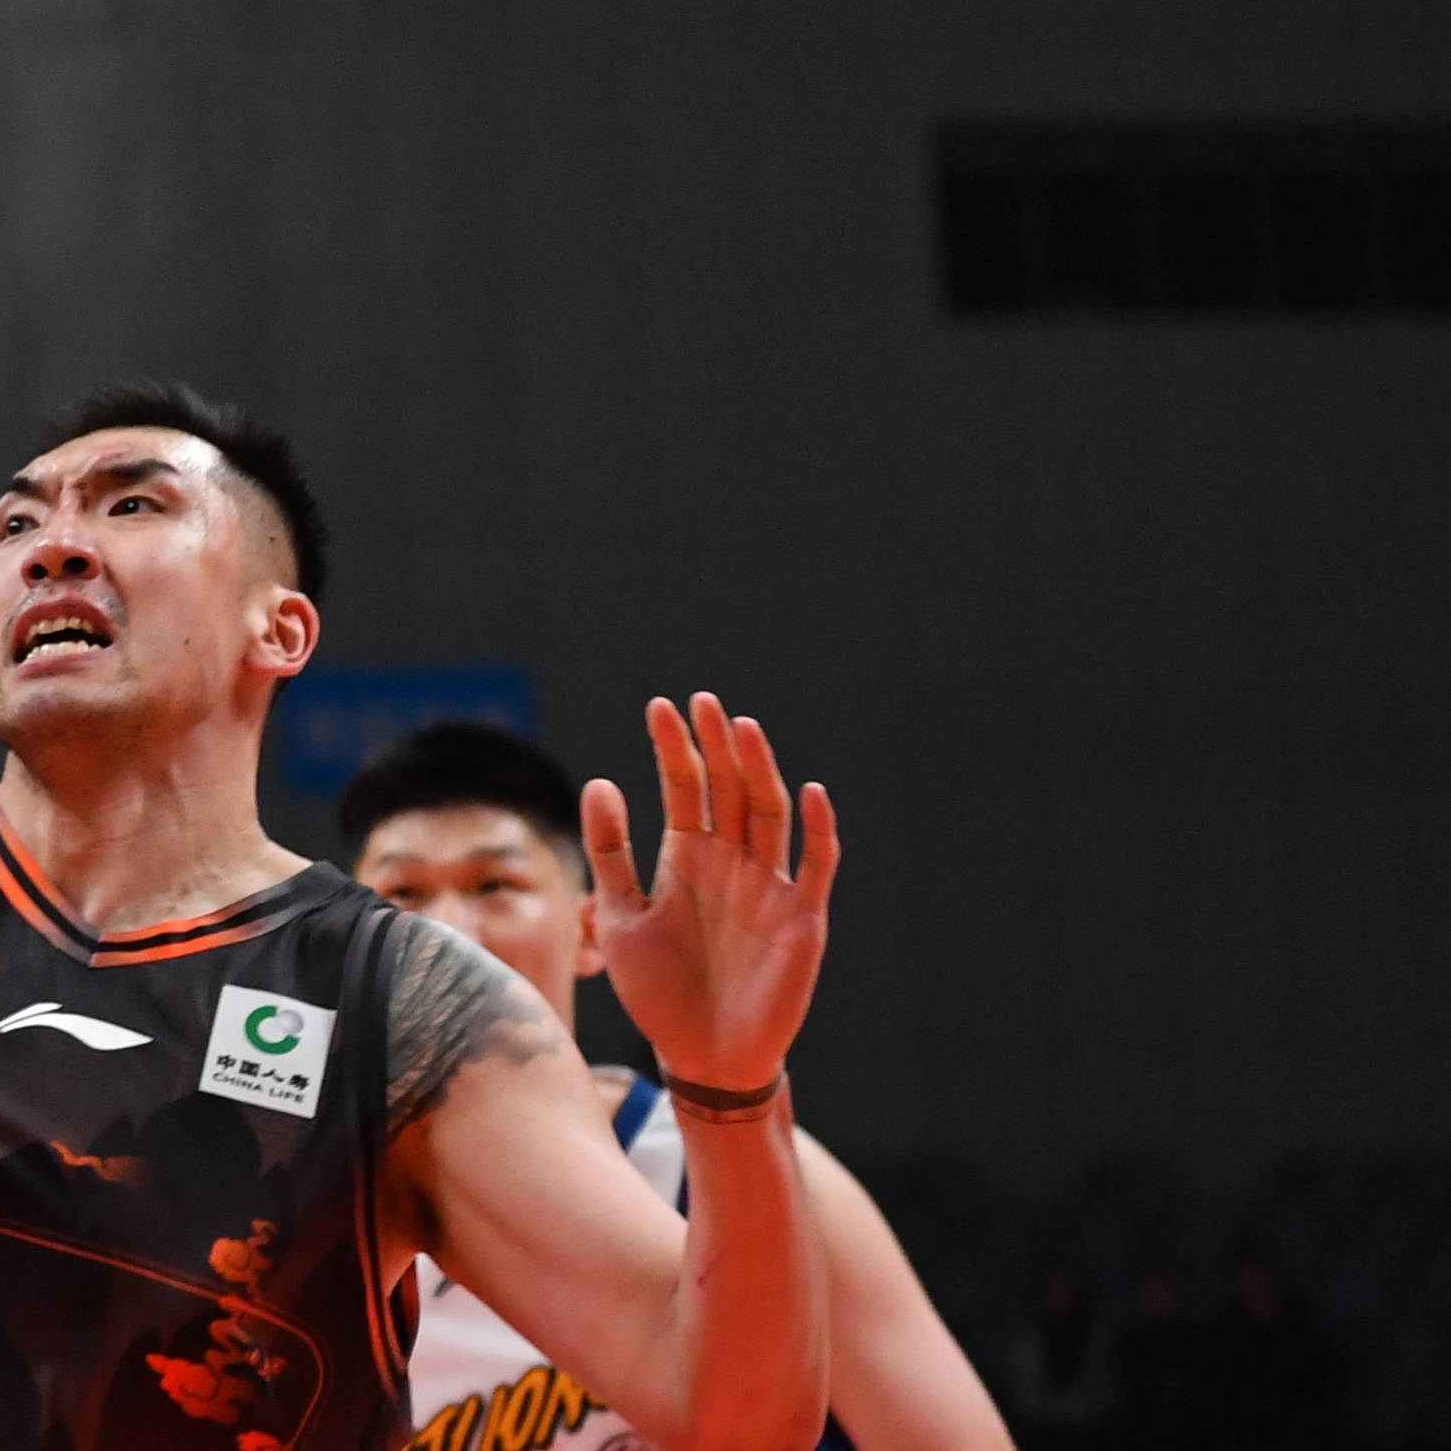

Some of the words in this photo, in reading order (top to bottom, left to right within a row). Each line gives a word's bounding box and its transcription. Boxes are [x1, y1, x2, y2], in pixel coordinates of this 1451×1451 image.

[213, 1072, 263, 1091] CHINA
[269, 1088, 304, 1103] LIFE
[216, 1054, 310, 1089] 中国人寿
